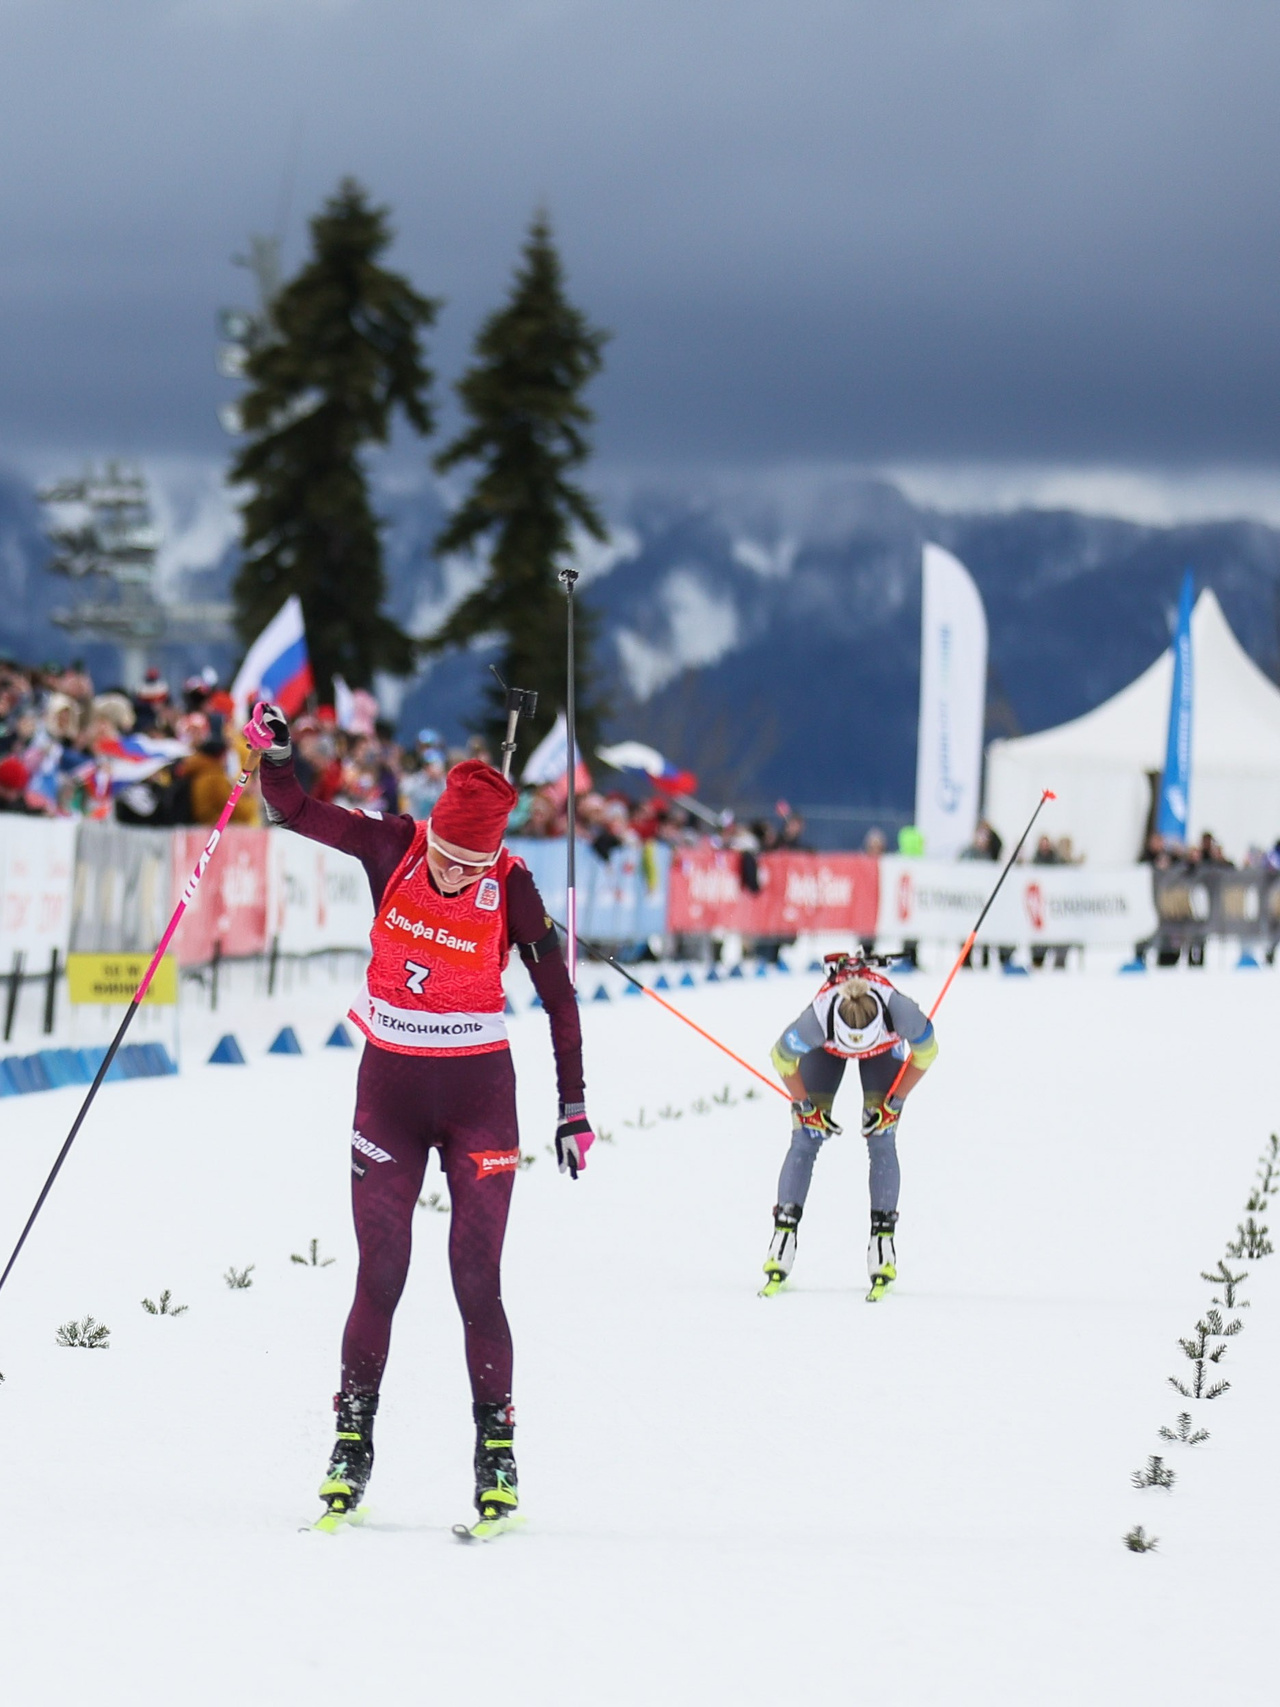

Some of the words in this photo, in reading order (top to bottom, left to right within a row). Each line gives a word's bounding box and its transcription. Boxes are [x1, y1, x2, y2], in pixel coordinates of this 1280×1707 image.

[384, 906, 435, 940] Альфа
[435, 928, 478, 953] Банк
[404, 959, 431, 995] 7
[377, 1012, 483, 1035] ТЕХНОНИКОЛЬ
